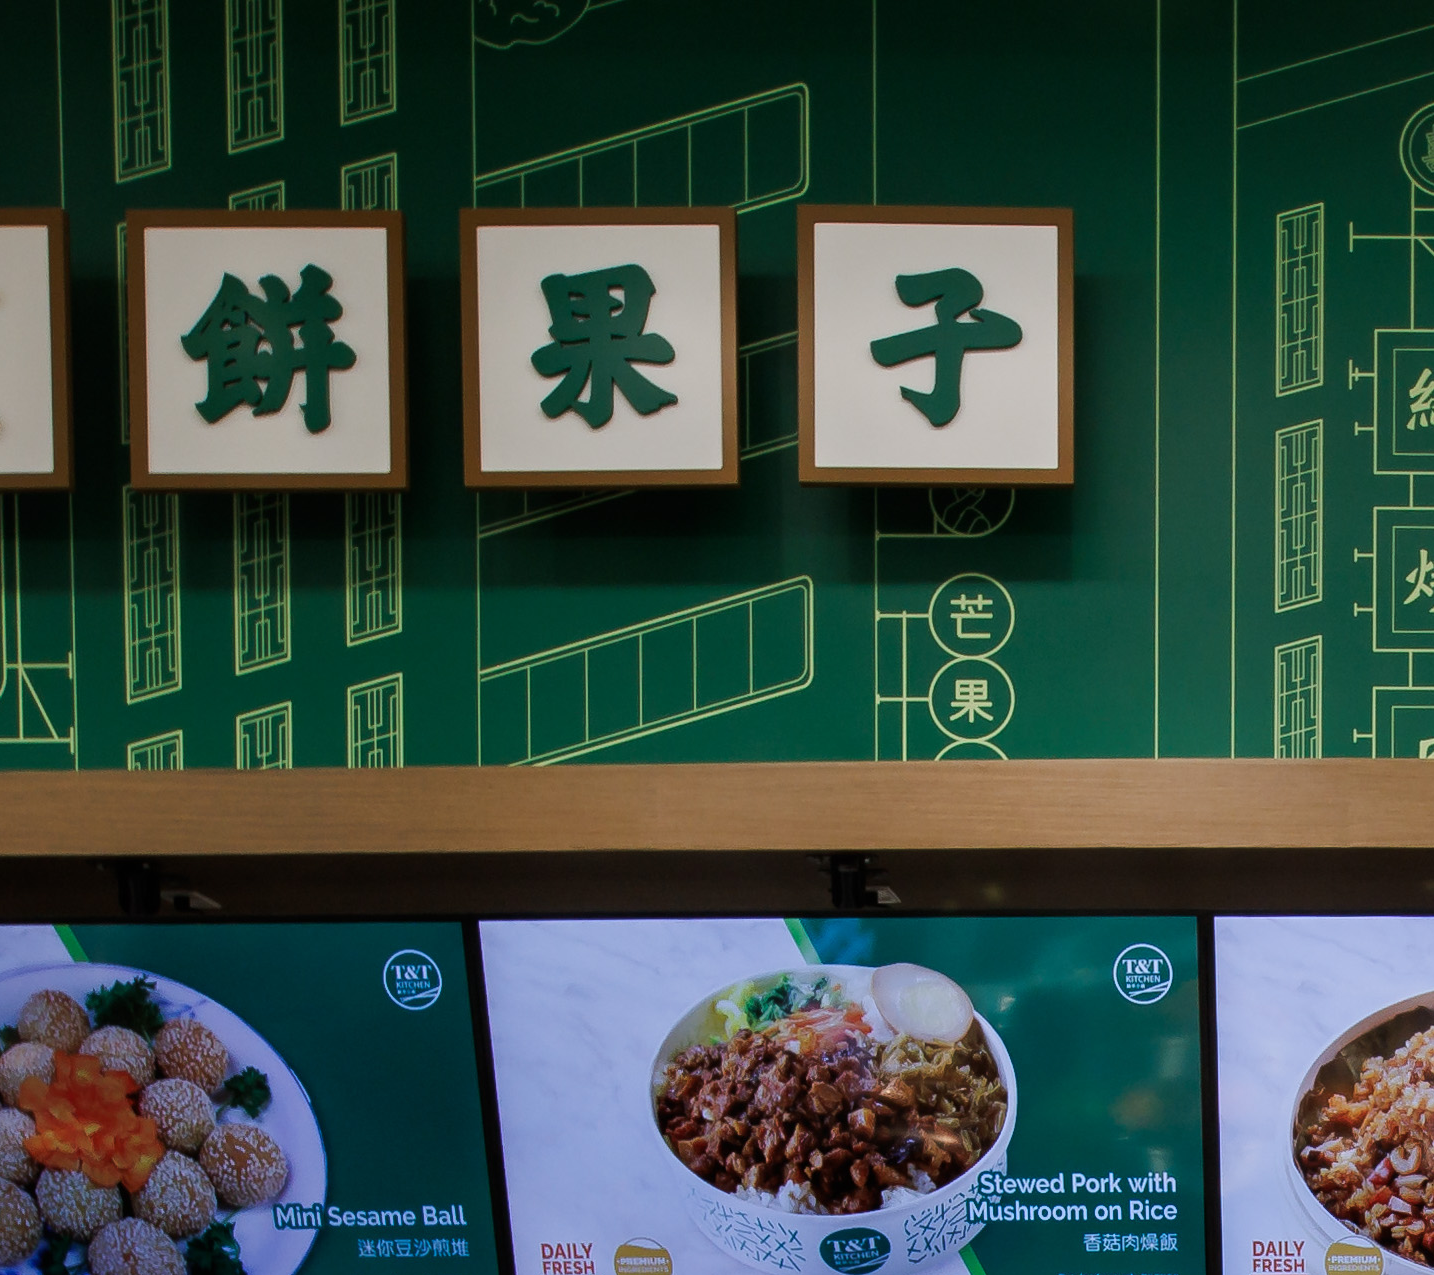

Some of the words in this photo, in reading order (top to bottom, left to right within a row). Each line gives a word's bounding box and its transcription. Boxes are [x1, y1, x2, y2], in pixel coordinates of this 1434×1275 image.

[949, 593, 995, 725] 芒果
[390, 964, 432, 979] T&T
[1122, 958, 1163, 974] T&T
[1126, 975, 1161, 983] KITCHEN
[979, 1173, 1065, 1194] Stewed
[1073, 1173, 1122, 1193] Pork
[1128, 1173, 1176, 1193] with
[275, 1205, 322, 1227] Mini
[328, 1206, 416, 1227] Sesame
[422, 1204, 468, 1226] Ball
[968, 1199, 1088, 1221] Mushroom
[1095, 1205, 1122, 1220] on
[1129, 1199, 1178, 1220] Rice
[358, 1238, 470, 1258] 迷你豆沙煎堆
[826, 1235, 881, 1253] T&T
[1083, 1232, 1179, 1252] 香菇肉燥飯
[1252, 1240, 1305, 1257] DAILY
[540, 1242, 593, 1260] DAILY
[833, 1250, 880, 1261] KITCHEN
[1331, 1255, 1378, 1264] PREMIUM
[542, 1260, 595, 1275] FRESH
[620, 1256, 667, 1266] PREMIUM
[1252, 1258, 1305, 1273] FRESH
